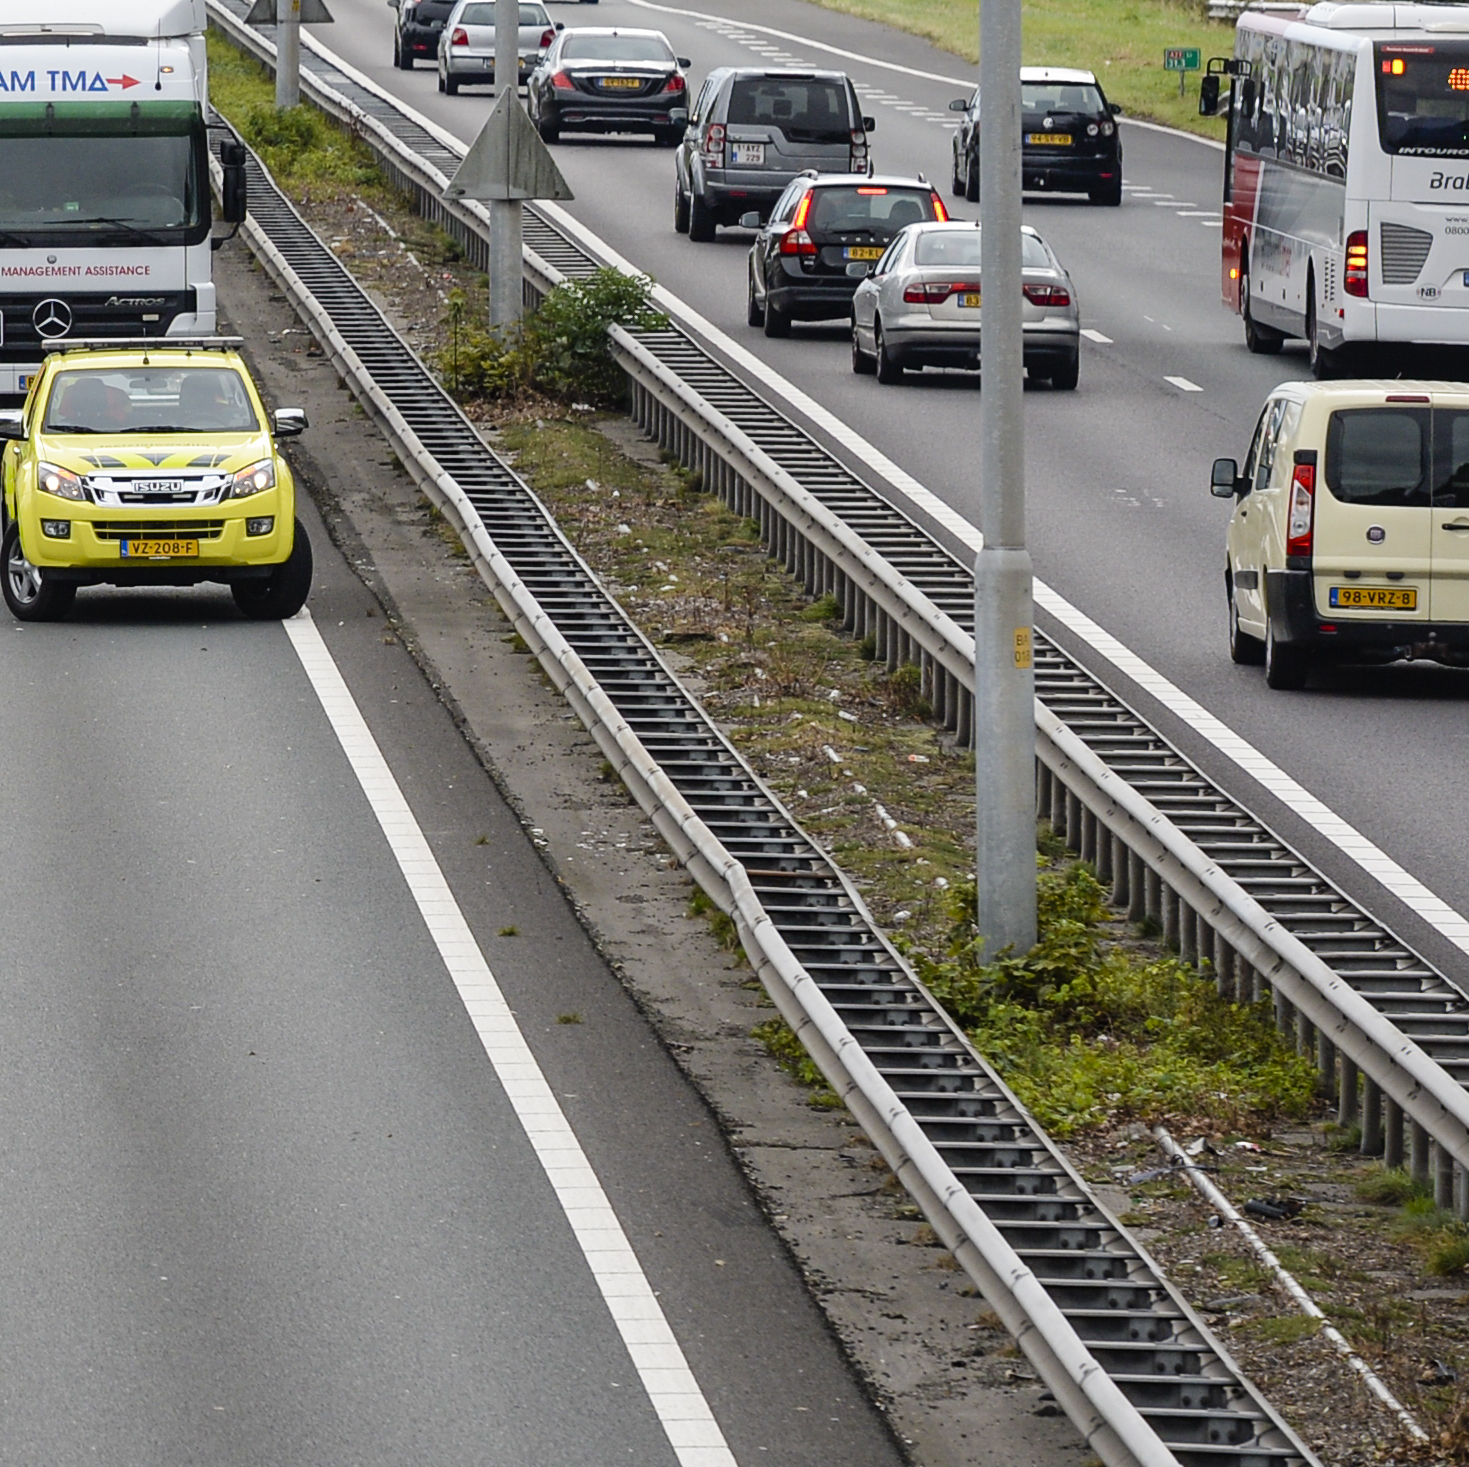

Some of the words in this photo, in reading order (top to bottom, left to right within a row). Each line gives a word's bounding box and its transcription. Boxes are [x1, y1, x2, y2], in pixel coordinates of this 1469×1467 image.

[47, 70, 109, 92] TMA
[1, 266, 82, 277] MANAGEMENT
[84, 265, 151, 276] ASSISTANCE
[134, 482, 182, 492] ISUZU
[132, 542, 193, 554] VZ-208-F
[1342, 590, 1410, 605] 98-VRZ-8
